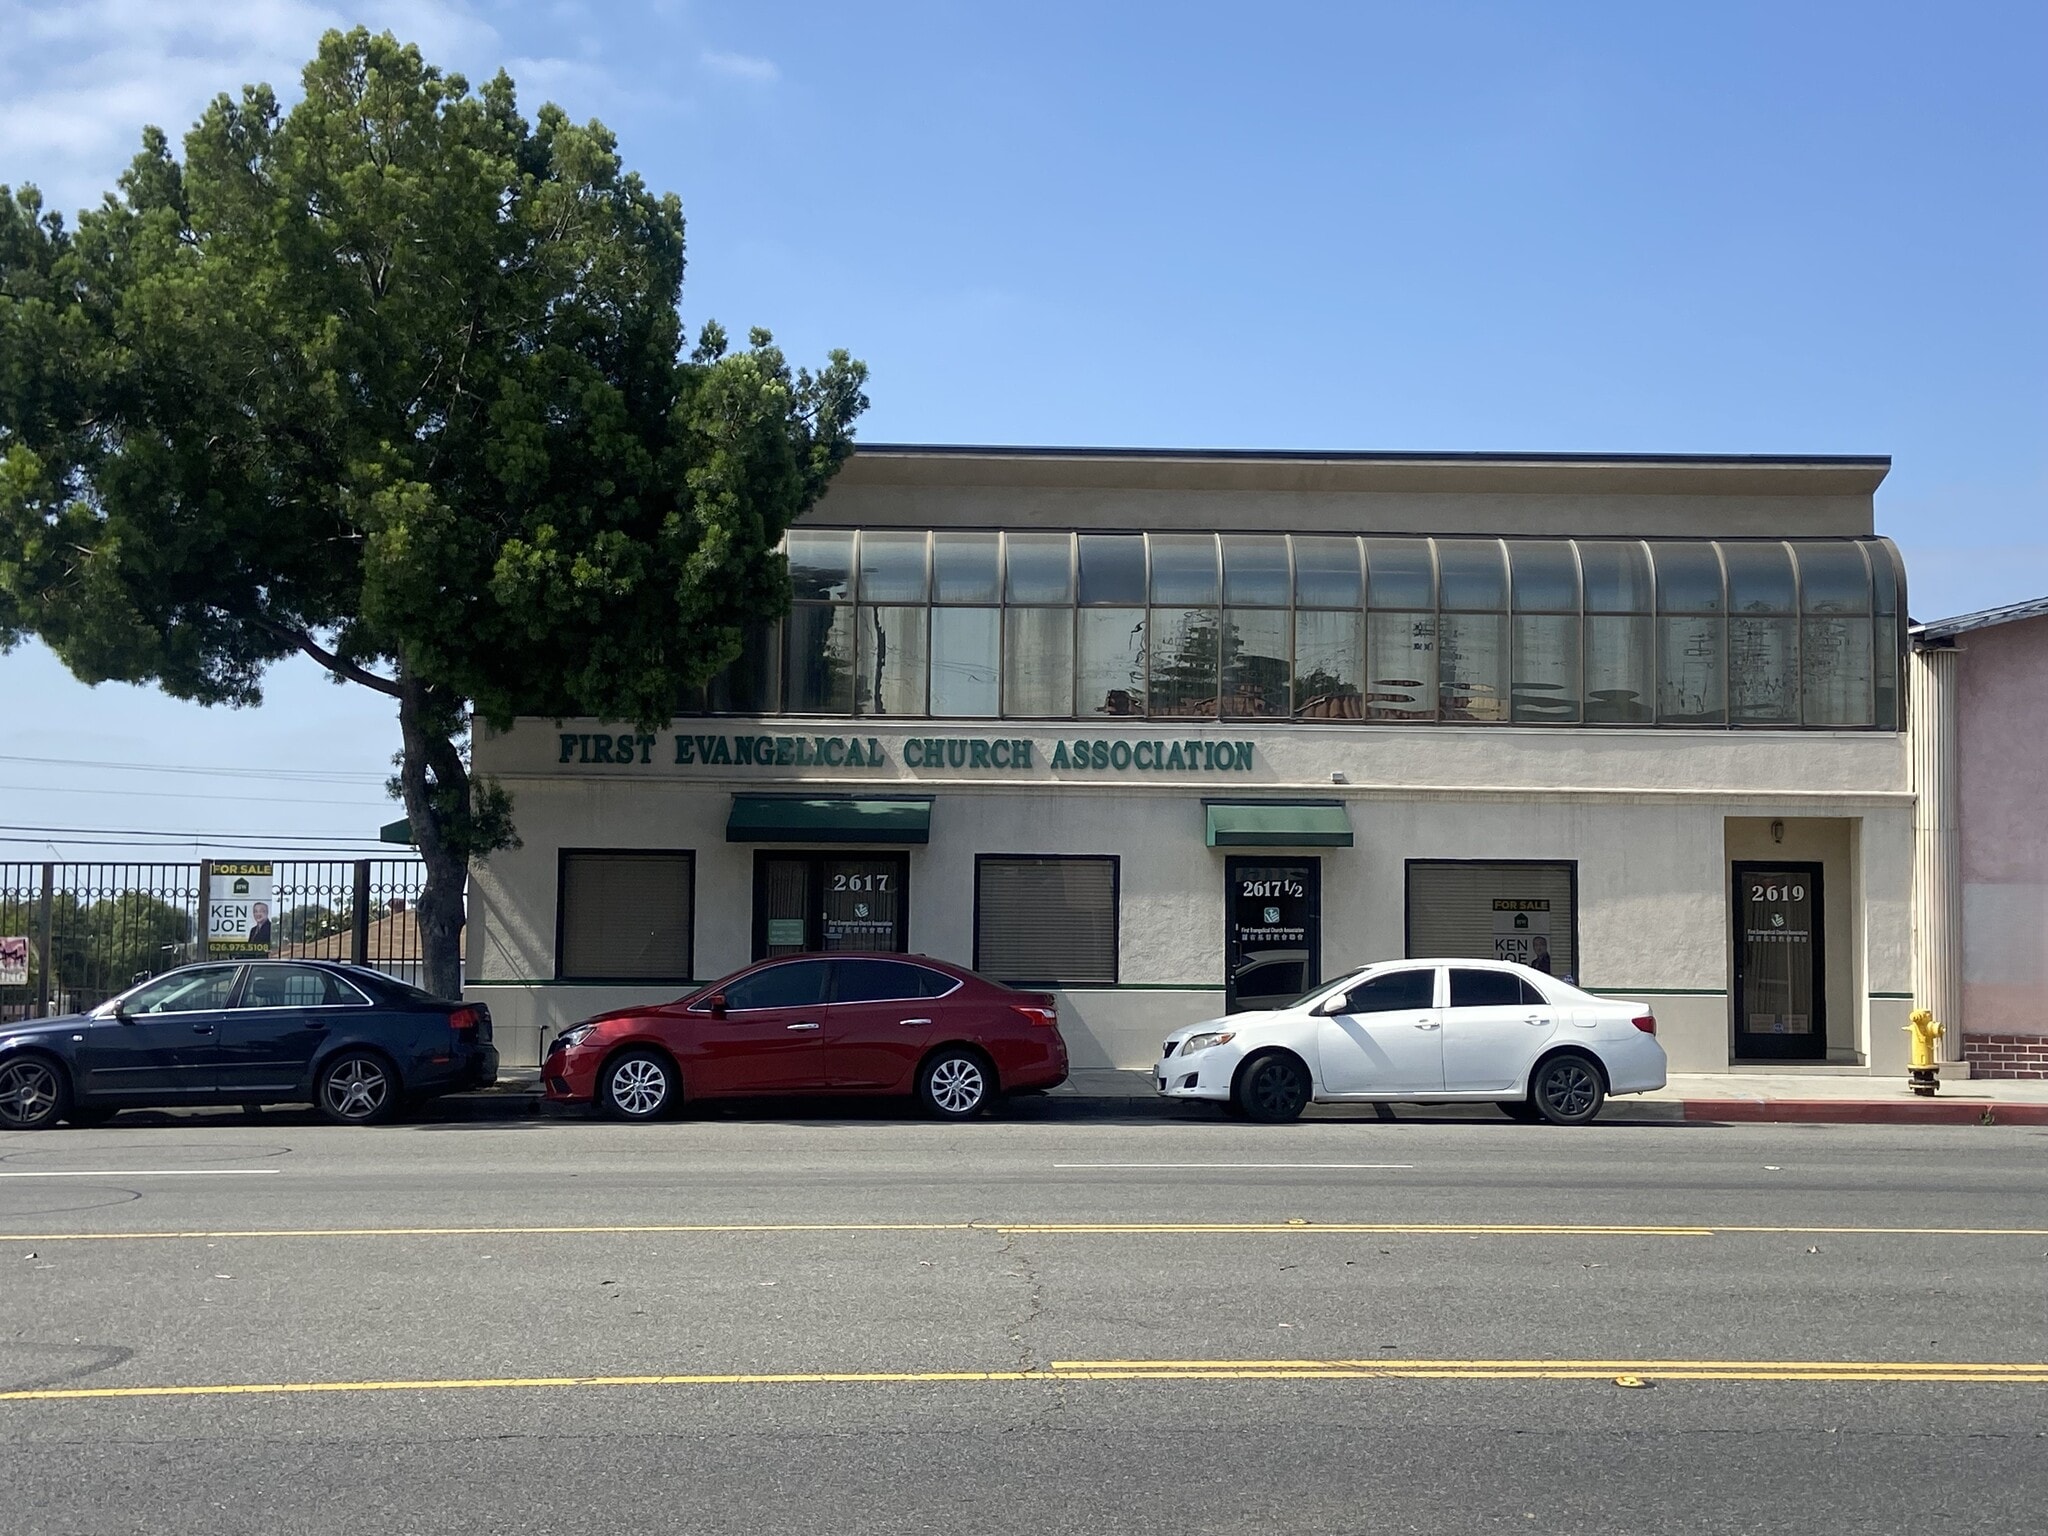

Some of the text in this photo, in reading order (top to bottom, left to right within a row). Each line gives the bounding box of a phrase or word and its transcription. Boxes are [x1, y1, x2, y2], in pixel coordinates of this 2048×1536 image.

[559, 734, 1255, 771] FIRST EVANGELICAL CHURCH ASSOCIATION
[213, 864, 272, 874] FOR SALE
[834, 874, 889, 891] 2617
[1243, 881, 1282, 897] 2617
[1751, 885, 1805, 901] 2619
[211, 905, 247, 918] KEN
[1494, 900, 1548, 910] FOR SALE
[210, 919, 246, 932] JOE
[209, 943, 269, 952] 626.975.5108
[1495, 939, 1528, 951] KEN
